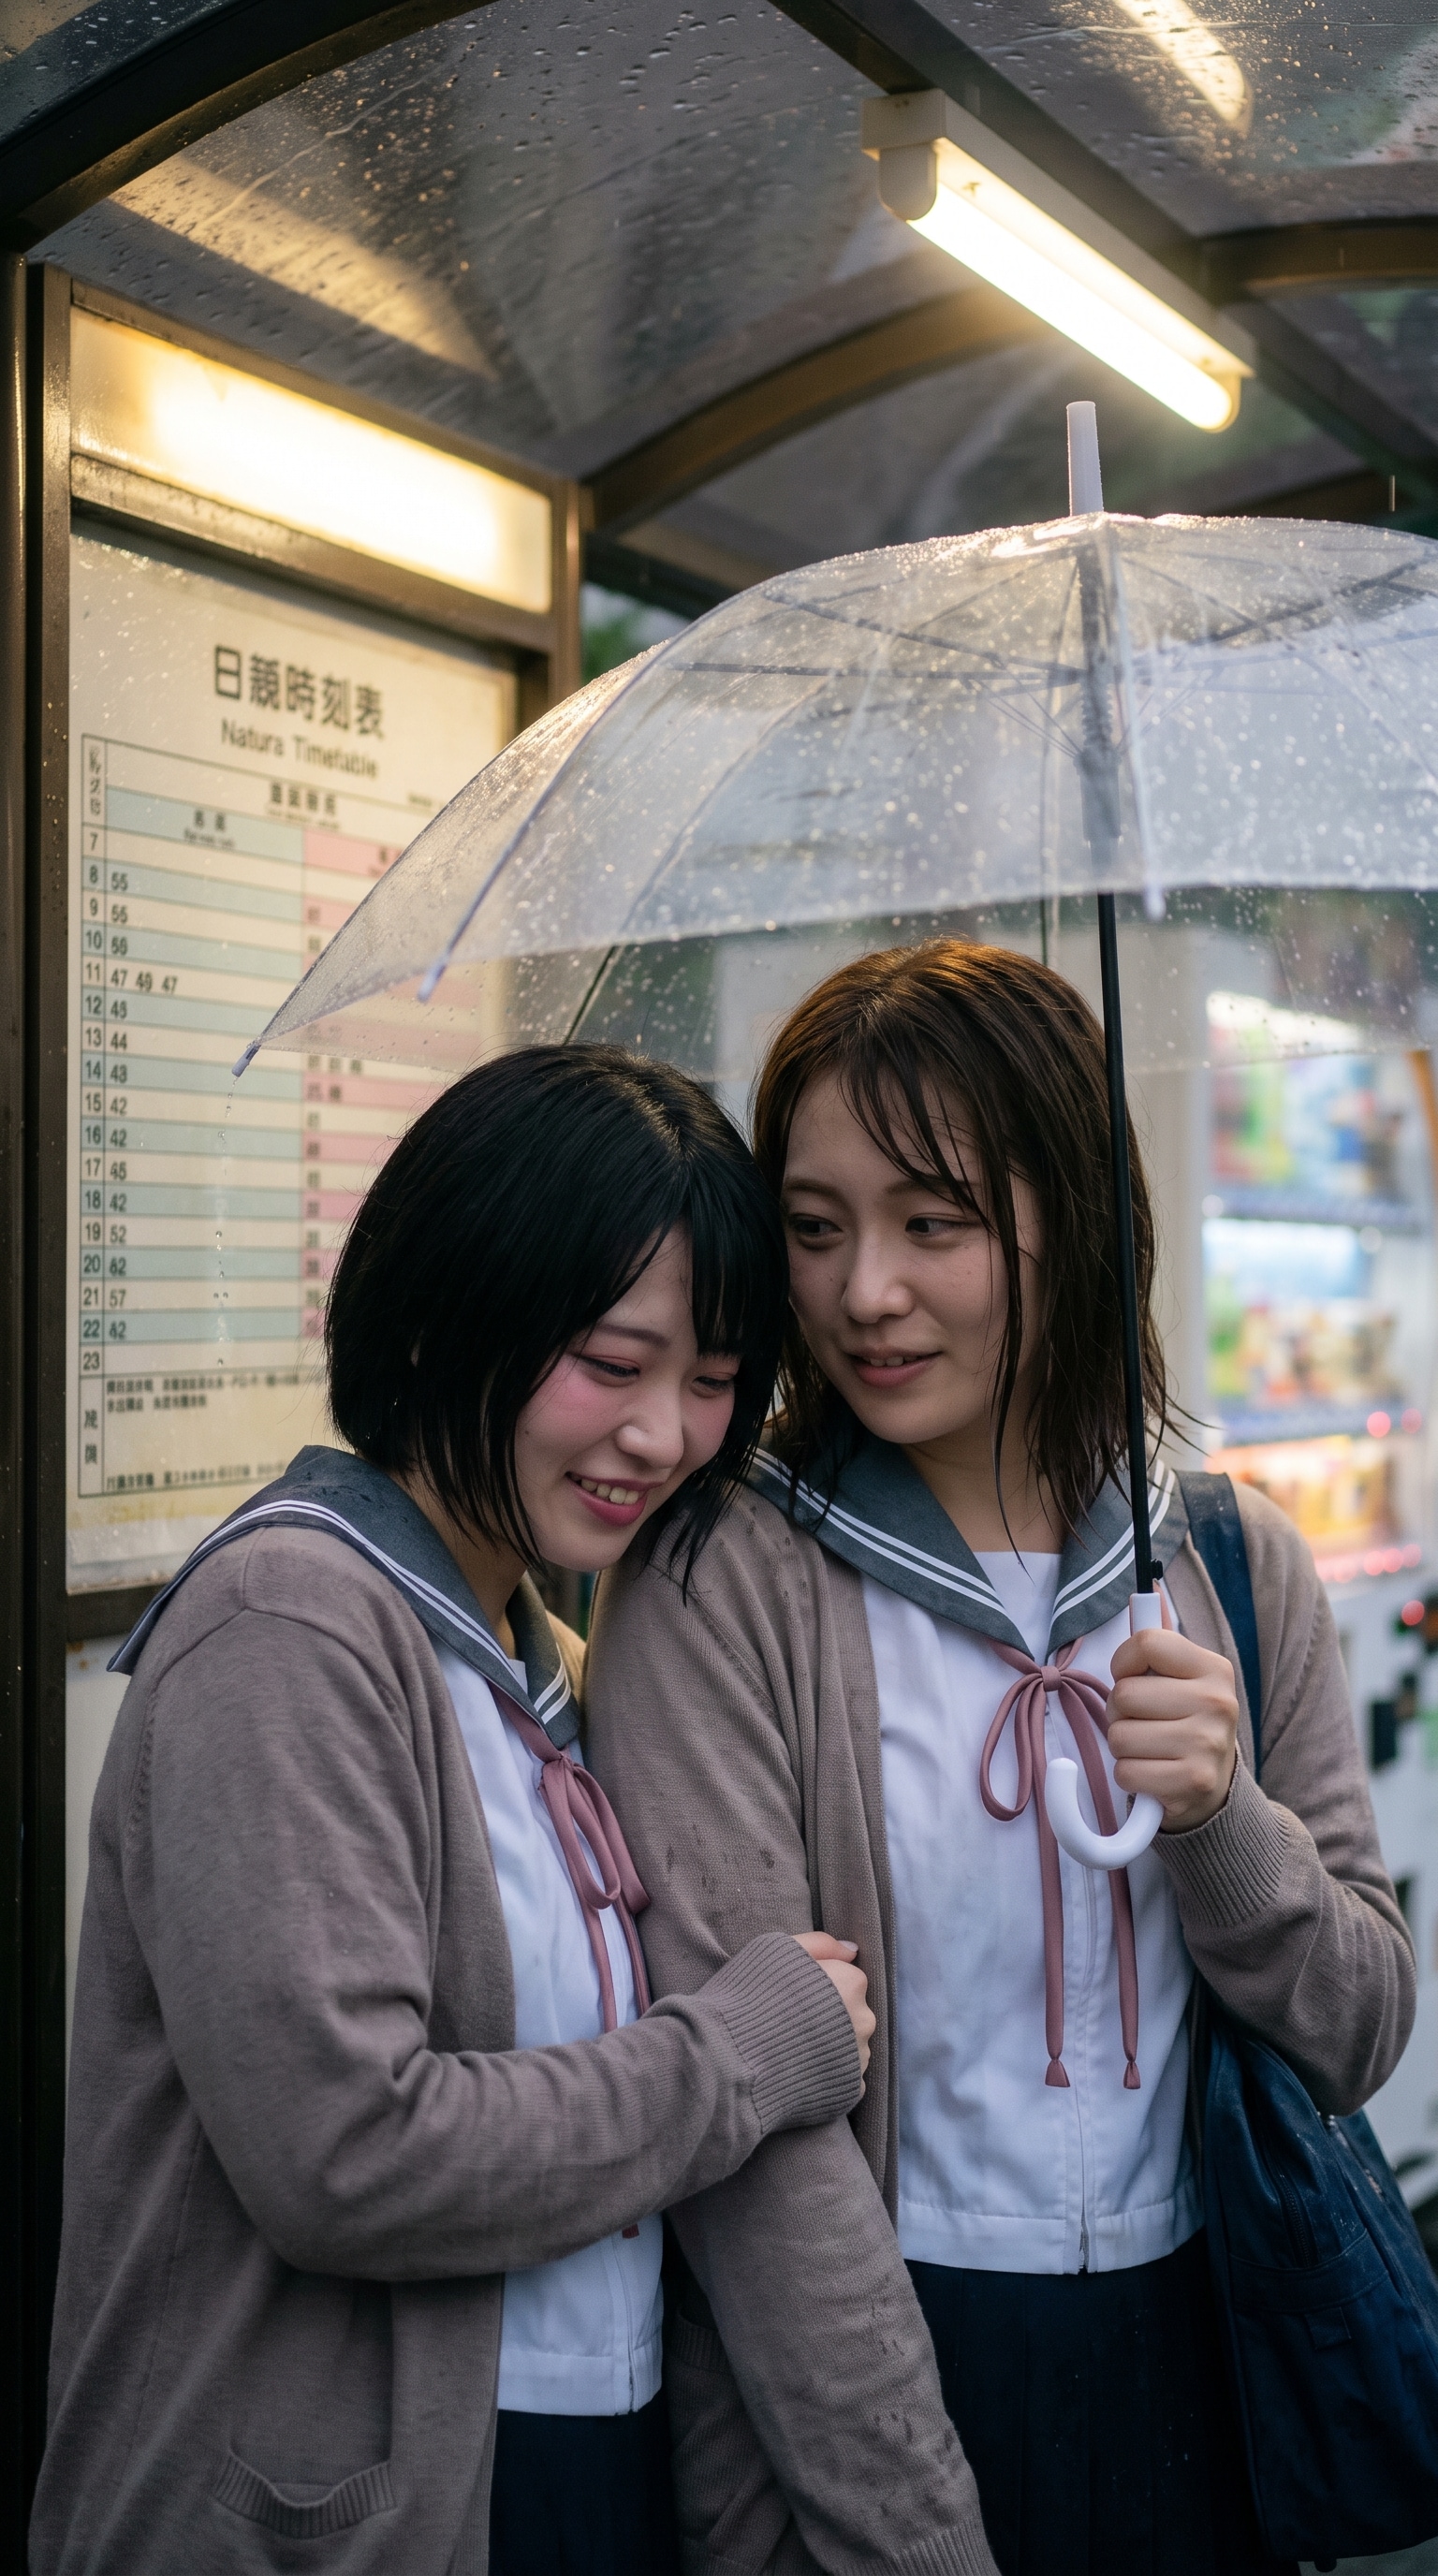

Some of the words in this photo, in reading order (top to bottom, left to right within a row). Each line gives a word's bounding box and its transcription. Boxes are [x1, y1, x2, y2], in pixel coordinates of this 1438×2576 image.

[90, 832, 98, 851] 7
[89, 864, 98, 884] 8
[89, 897, 98, 916] 9
[85, 929, 102, 950] 10
[85, 961, 100, 982] 11
[110, 968, 128, 988] 47
[85, 994, 102, 1015] 12
[85, 1026, 101, 1047] 13
[110, 1031, 127, 1051] 44
[85, 1059, 101, 1080] 14
[85, 1091, 101, 1112] 15
[110, 1095, 127, 1116] 42
[85, 1124, 101, 1145] 16
[110, 1128, 127, 1149] 42
[85, 1157, 101, 1177] 17
[85, 1190, 101, 1209] 18
[109, 1193, 127, 1213] 42
[85, 1222, 101, 1241] 19
[110, 1224, 126, 1245] 52
[83, 1253, 101, 1274] 20
[83, 1286, 98, 1307] 21
[110, 1288, 126, 1308] 57
[82, 1318, 100, 1339] 22
[82, 1351, 100, 1371] 23
